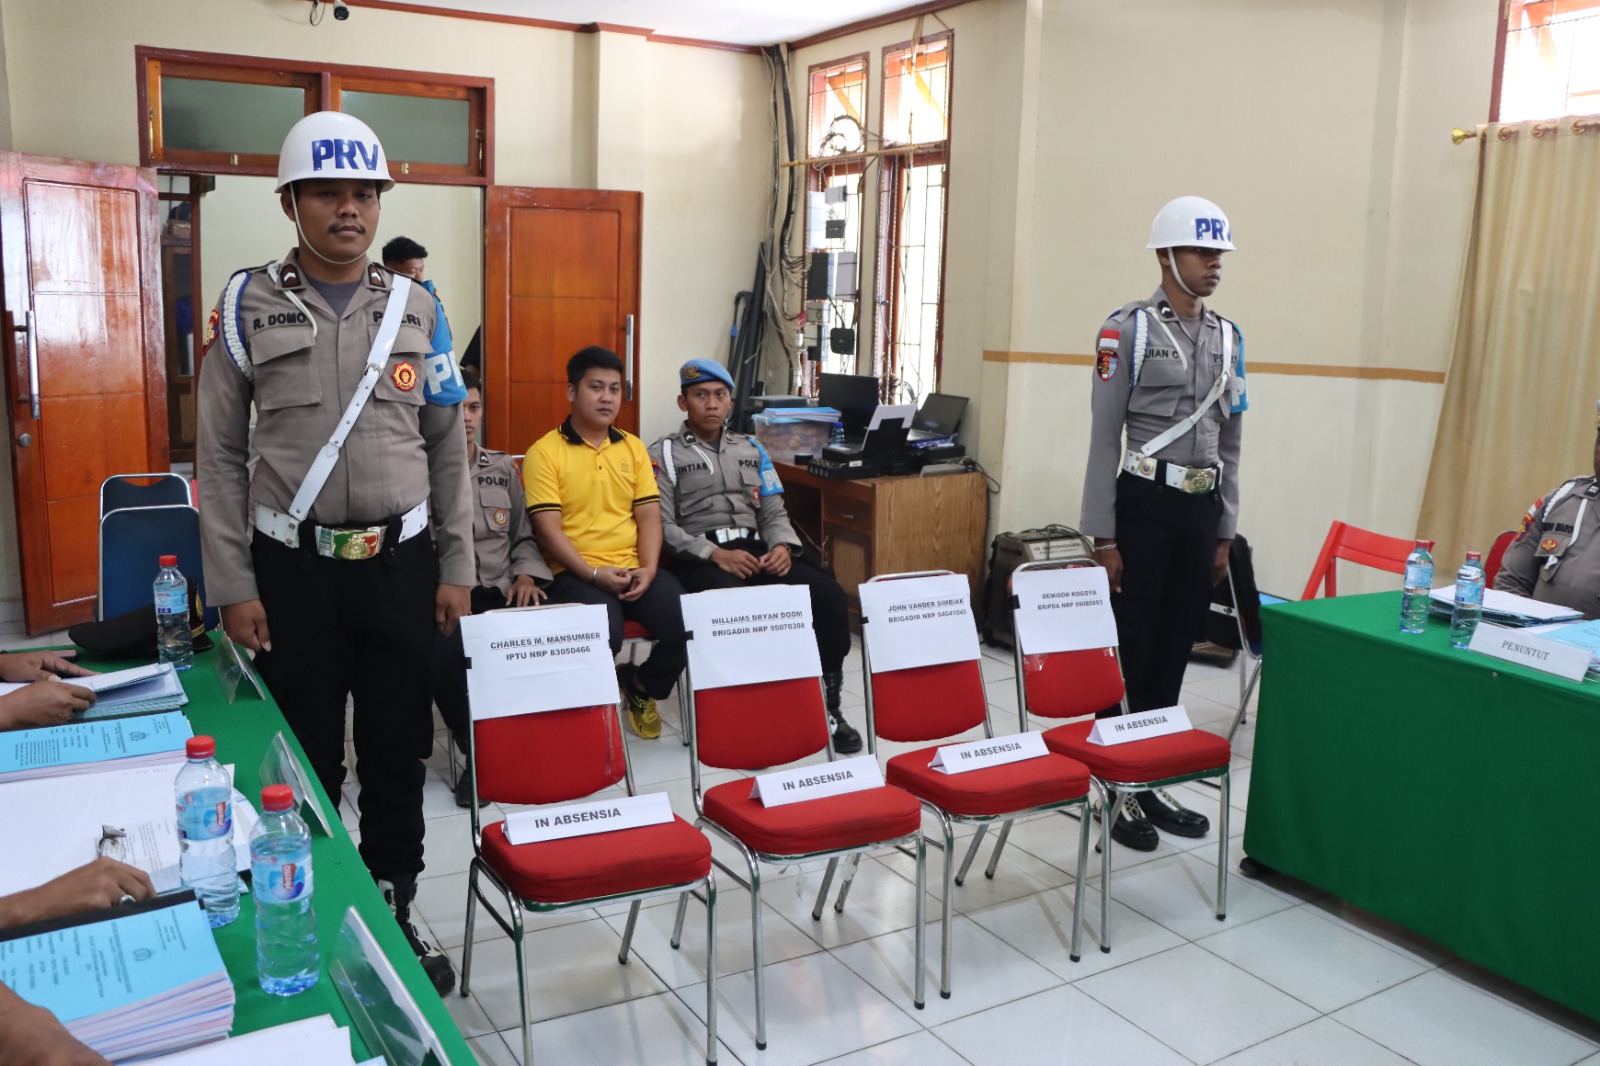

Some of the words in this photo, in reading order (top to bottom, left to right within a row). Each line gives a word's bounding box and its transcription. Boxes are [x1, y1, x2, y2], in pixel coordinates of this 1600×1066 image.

[312, 139, 378, 171] PRV
[253, 318, 264, 331] R.
[478, 476, 508, 488] POLRI
[888, 604, 907, 612] JOHN
[908, 601, 935, 610] VANDER
[937, 598, 964, 607] SIMBIAK
[711, 615, 750, 625] WILLIAMS
[752, 612, 779, 621] BRYAN
[780, 611, 803, 619] DOOM
[888, 614, 921, 623] BRIGADIR
[712, 627, 750, 637] BRIGADIR
[770, 622, 805, 631] 95070308
[490, 638, 532, 649] CHARLES
[547, 632, 601, 644] MANSUMBER
[506, 652, 527, 661] IPTU
[530, 650, 547, 658] NRP
[550, 646, 591, 656] 83050466
[1501, 640, 1551, 661] PENUNTUT
[1114, 723, 1125, 732] IN
[1127, 716, 1168, 730] ABSENSIA
[960, 751, 972, 760] IN
[974, 742, 1022, 757] ABSENSIA
[782, 781, 796, 791] IN
[798, 770, 854, 788] ABSENSIA
[534, 818, 550, 829] IN
[554, 808, 621, 826] ABSENSIA
